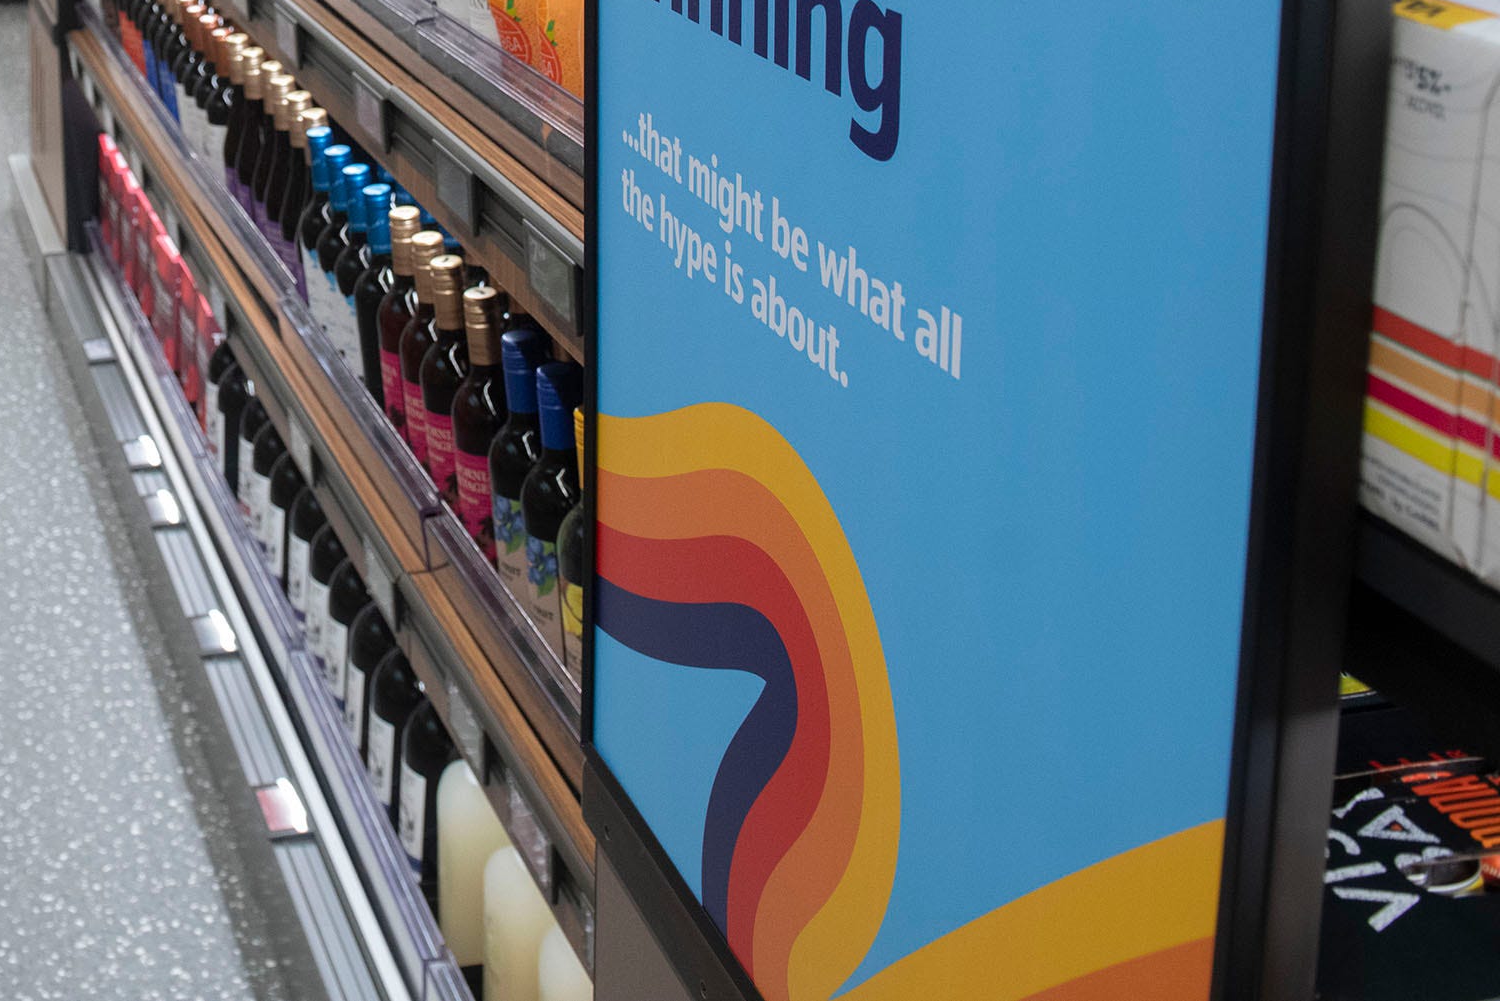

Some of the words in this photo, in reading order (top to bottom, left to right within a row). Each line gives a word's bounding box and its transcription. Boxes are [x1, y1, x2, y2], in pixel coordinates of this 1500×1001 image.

[621, 168, 655, 232] the
[660, 193, 718, 284] hype
[724, 239, 745, 305] is
[751, 274, 849, 388] about.
[688, 153, 765, 243] might
[771, 196, 809, 272] be
[817, 241, 906, 342] what
[914, 305, 963, 380] all
